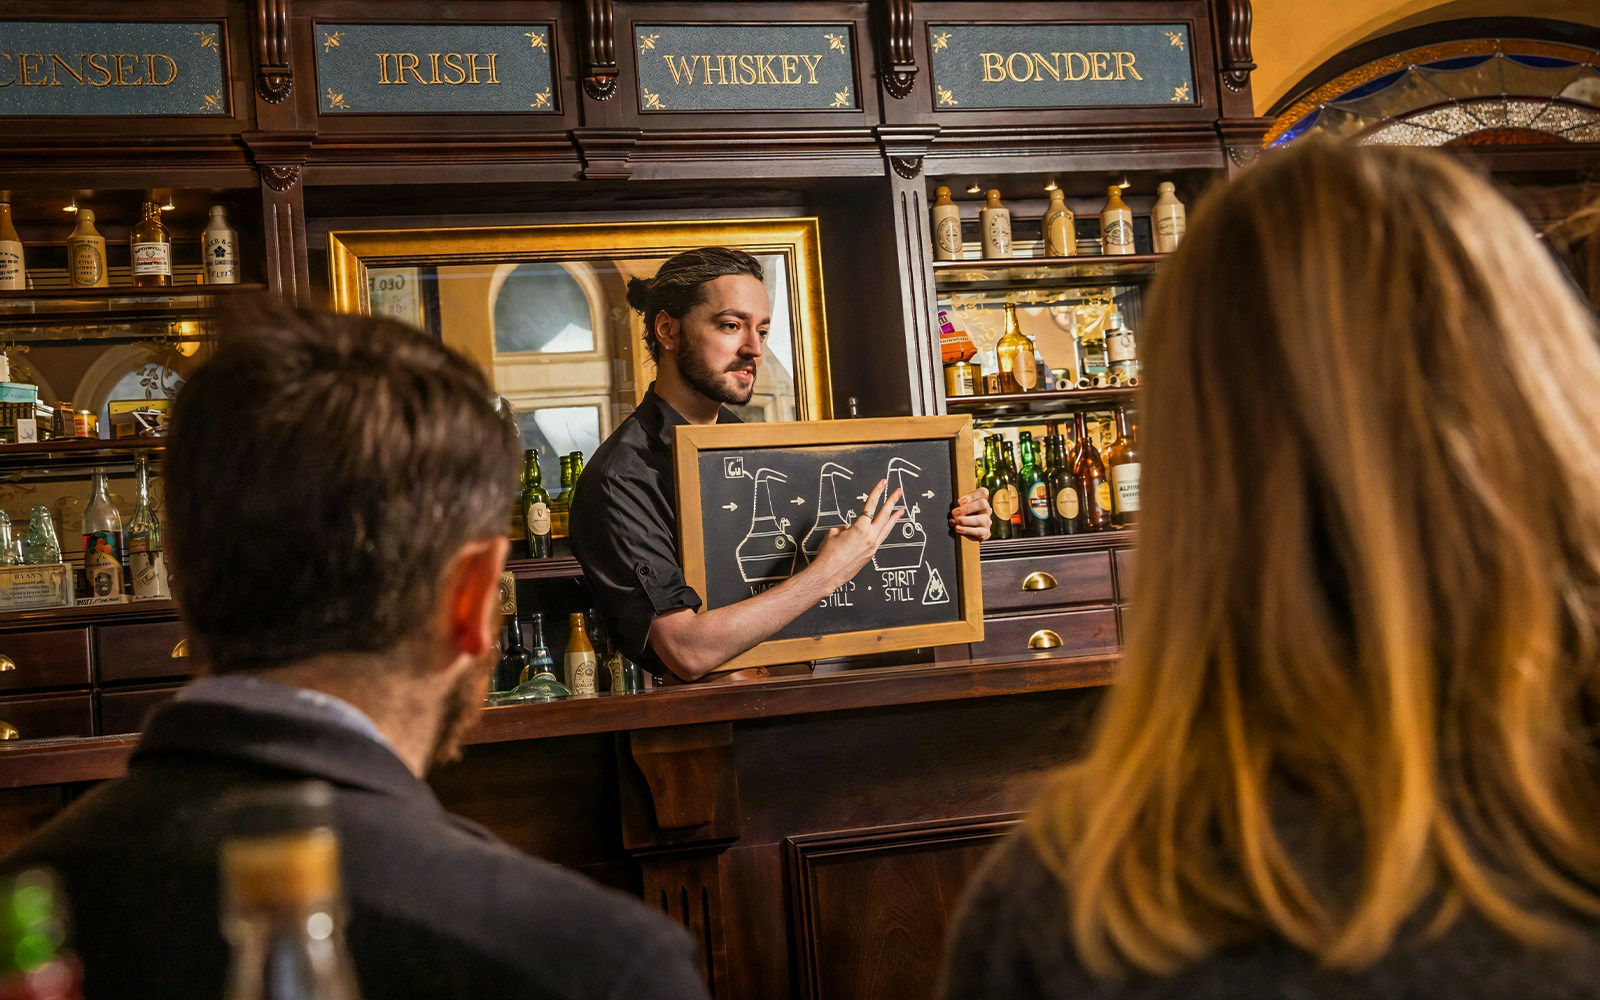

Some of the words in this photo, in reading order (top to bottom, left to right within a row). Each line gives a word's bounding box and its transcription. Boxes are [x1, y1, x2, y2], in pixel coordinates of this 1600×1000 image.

[376, 53, 501, 85] IRISH
[663, 54, 823, 86] WHISKEY
[979, 51, 1143, 82] BONDER
[882, 569, 917, 588] SPIRIT
[885, 587, 914, 602] STILL
